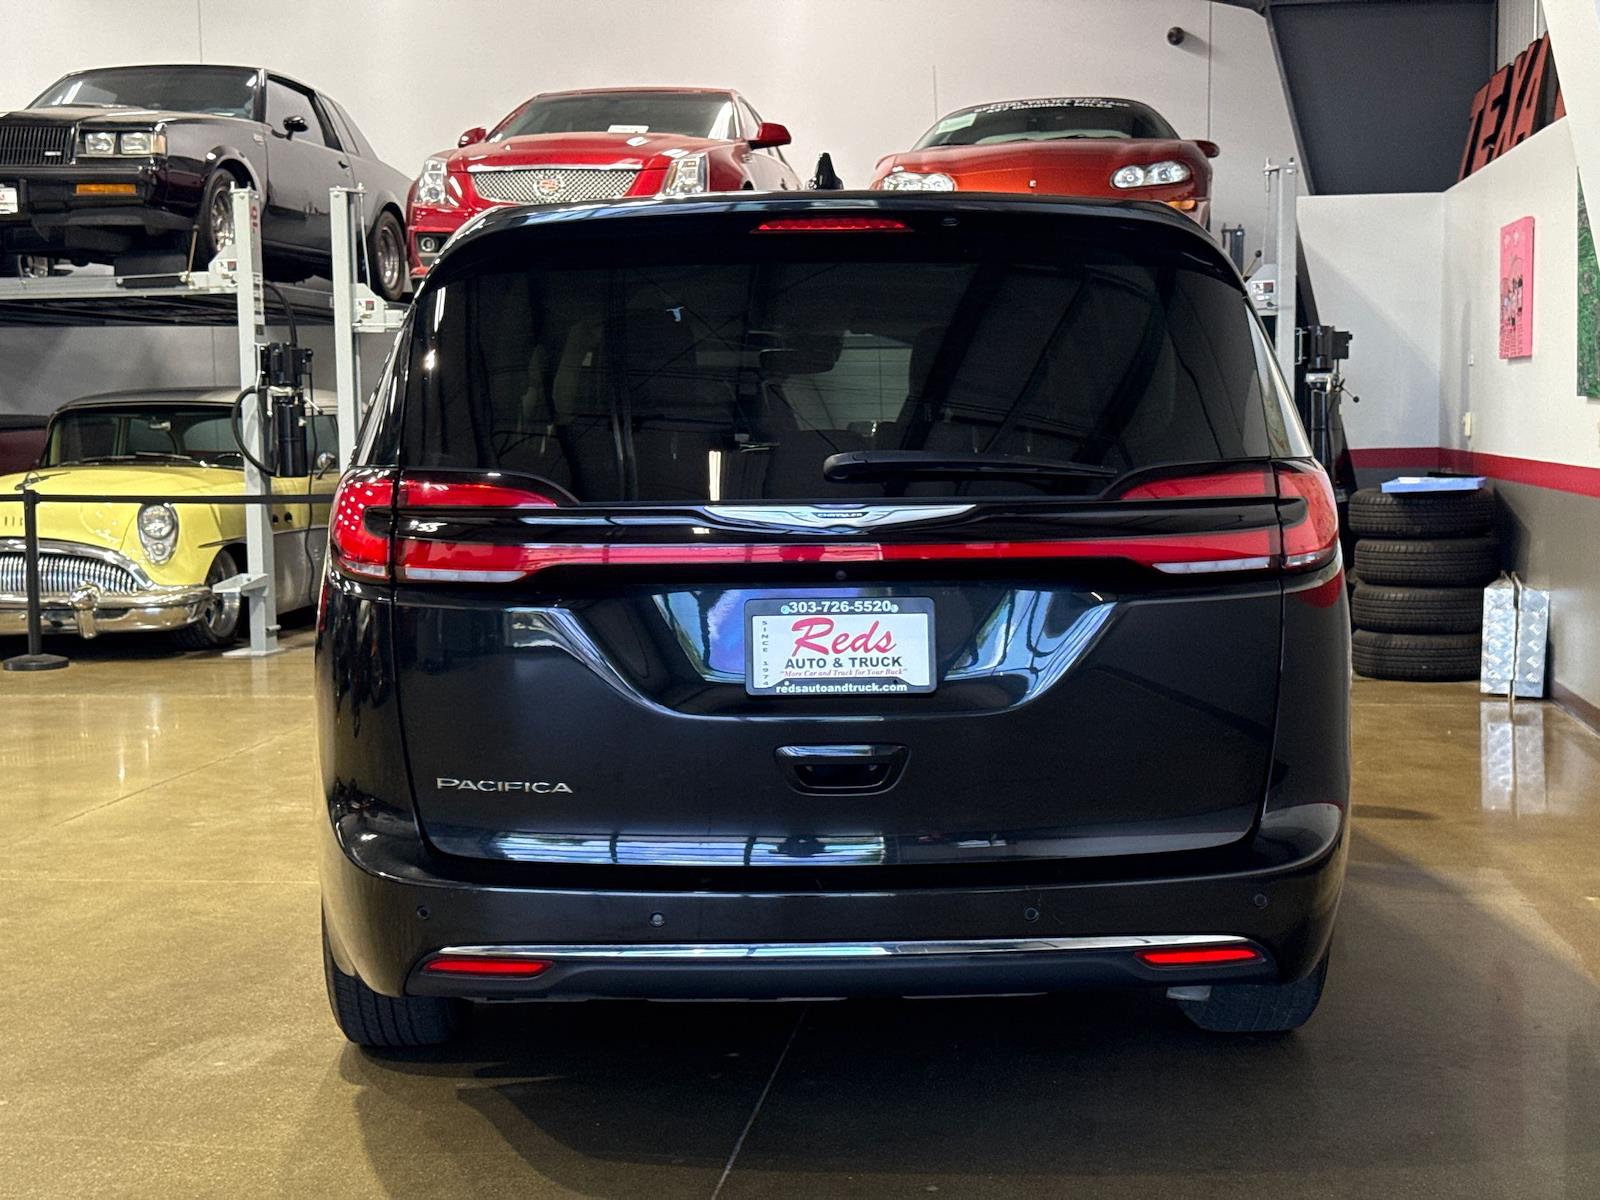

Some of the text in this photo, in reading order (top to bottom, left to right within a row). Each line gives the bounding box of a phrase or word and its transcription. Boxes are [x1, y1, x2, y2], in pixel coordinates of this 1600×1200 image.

[1457, 31, 1567, 181] TEXA
[789, 601, 891, 613] 303-726-5520
[761, 620, 769, 653] SINCE
[791, 617, 897, 657] Reds
[785, 656, 903, 669] AUTO & TRUCK
[854, 669, 866, 677] for
[867, 668, 884, 676] Your
[776, 682, 908, 693] redsautoandtruck.com
[436, 777, 573, 794] PACIFICA
